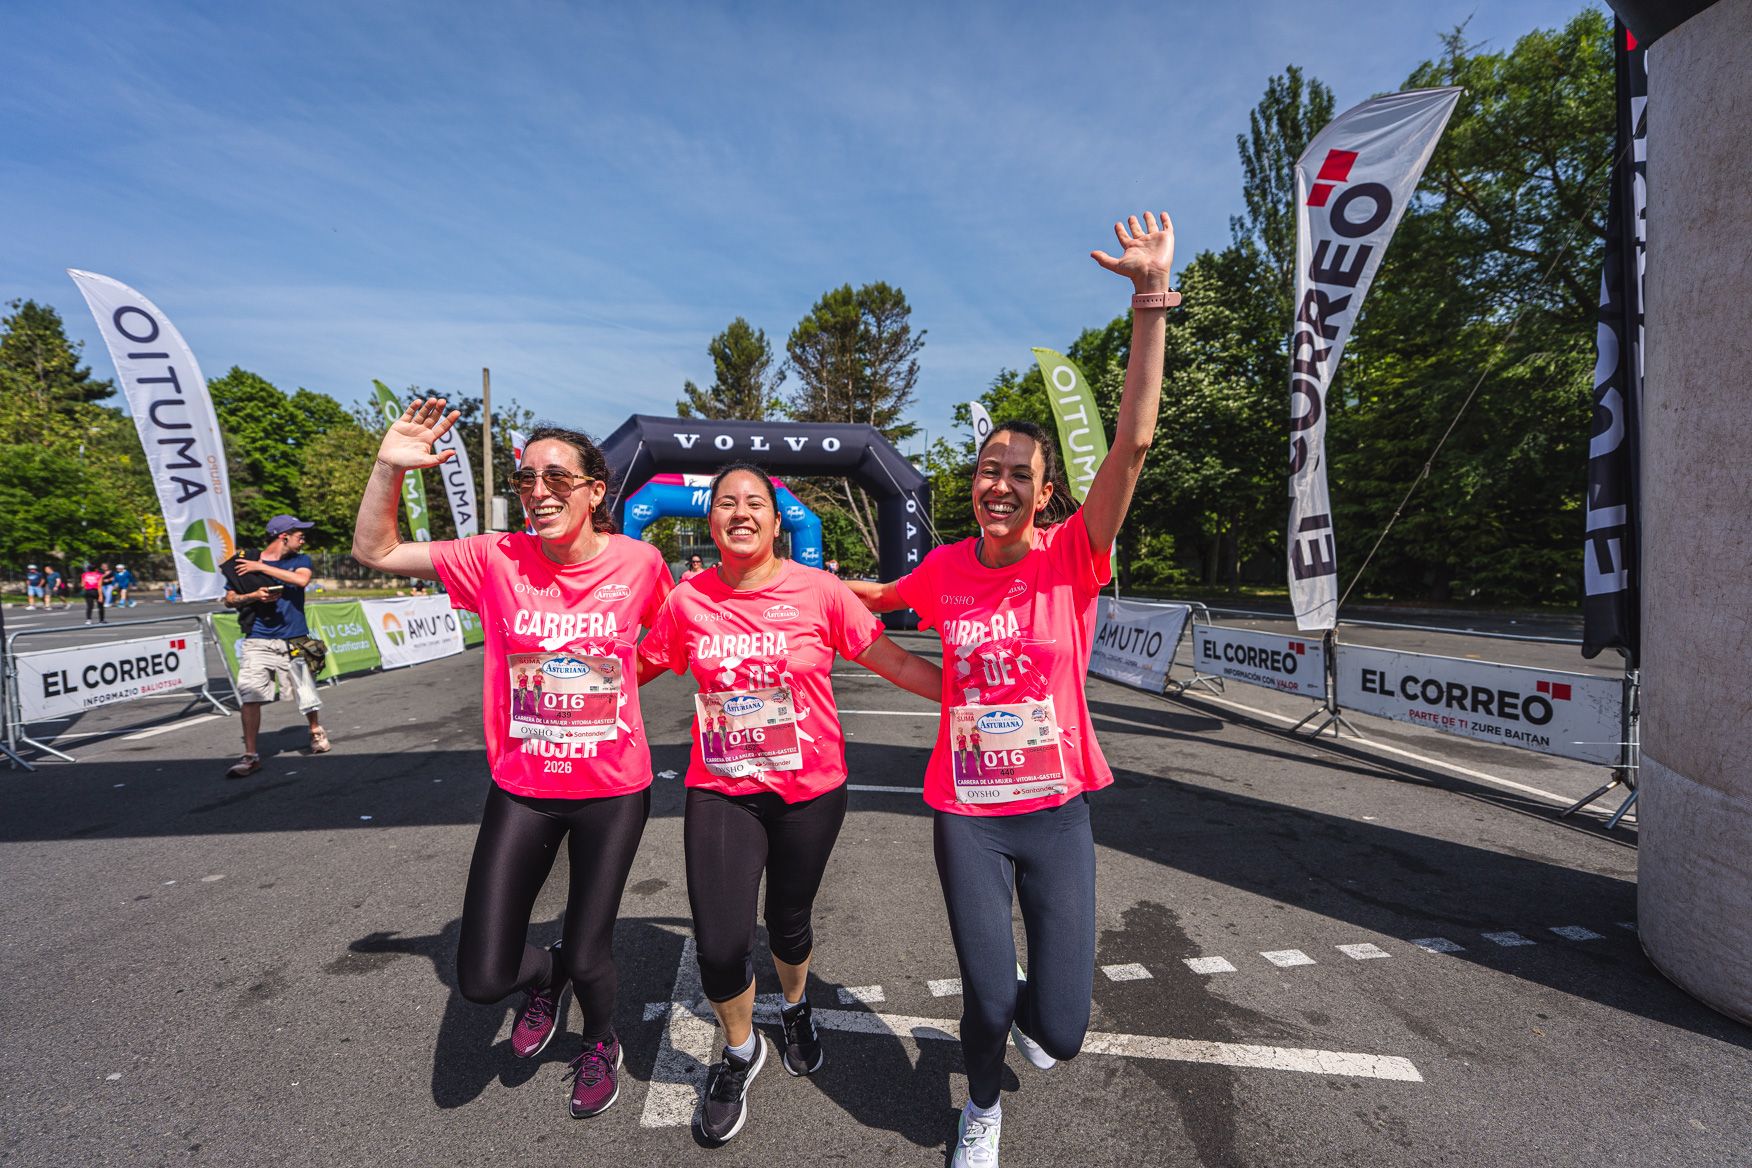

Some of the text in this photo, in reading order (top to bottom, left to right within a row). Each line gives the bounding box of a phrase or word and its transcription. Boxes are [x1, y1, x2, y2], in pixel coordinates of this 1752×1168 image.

[673, 433, 841, 451] VOLVO
[905, 499, 918, 562] LVO
[514, 583, 561, 598] OYSHO
[941, 594, 975, 606] OYSHO
[694, 611, 733, 622] OYSHO
[766, 609, 797, 619] ASTURIANA
[407, 613, 456, 640] AMUIO
[514, 608, 618, 637] CARRERA
[943, 610, 1021, 646] CARRERA
[697, 631, 789, 660] CARRERA
[1096, 622, 1163, 658] AMUTIO
[1203, 639, 1298, 675] EL CORREO
[42, 651, 180, 698] EL CORREO
[545, 663, 587, 674] ASTURIANA
[980, 651, 1016, 687] DE
[1223, 667, 1298, 690] INFORMACIÓN CON VALOR
[84, 678, 183, 707] INFORMAZIO BALIOTSUA
[1361, 668, 1553, 725] EL CORREO
[543, 693, 585, 709] 016
[726, 702, 761, 713] ASTURIANA
[514, 715, 535, 723] CARRERA
[535, 717, 543, 725] DE
[556, 711, 572, 719] 439
[520, 726, 553, 737] OYSHO
[980, 719, 1020, 729] ASTURIANA
[1408, 709, 1550, 747] PARTE DE TI ZURE BAITAN
[728, 728, 766, 745] 016
[520, 738, 598, 759] MUJER
[706, 755, 726, 763] CARRERA
[983, 749, 1026, 767] 016
[543, 760, 572, 774] 2026
[1000, 768, 1014, 776] 440
[1016, 772, 1061, 783] VITORIA-GASTEIZ
[967, 789, 1000, 798] OYSHO
[1021, 785, 1055, 795] Santander
